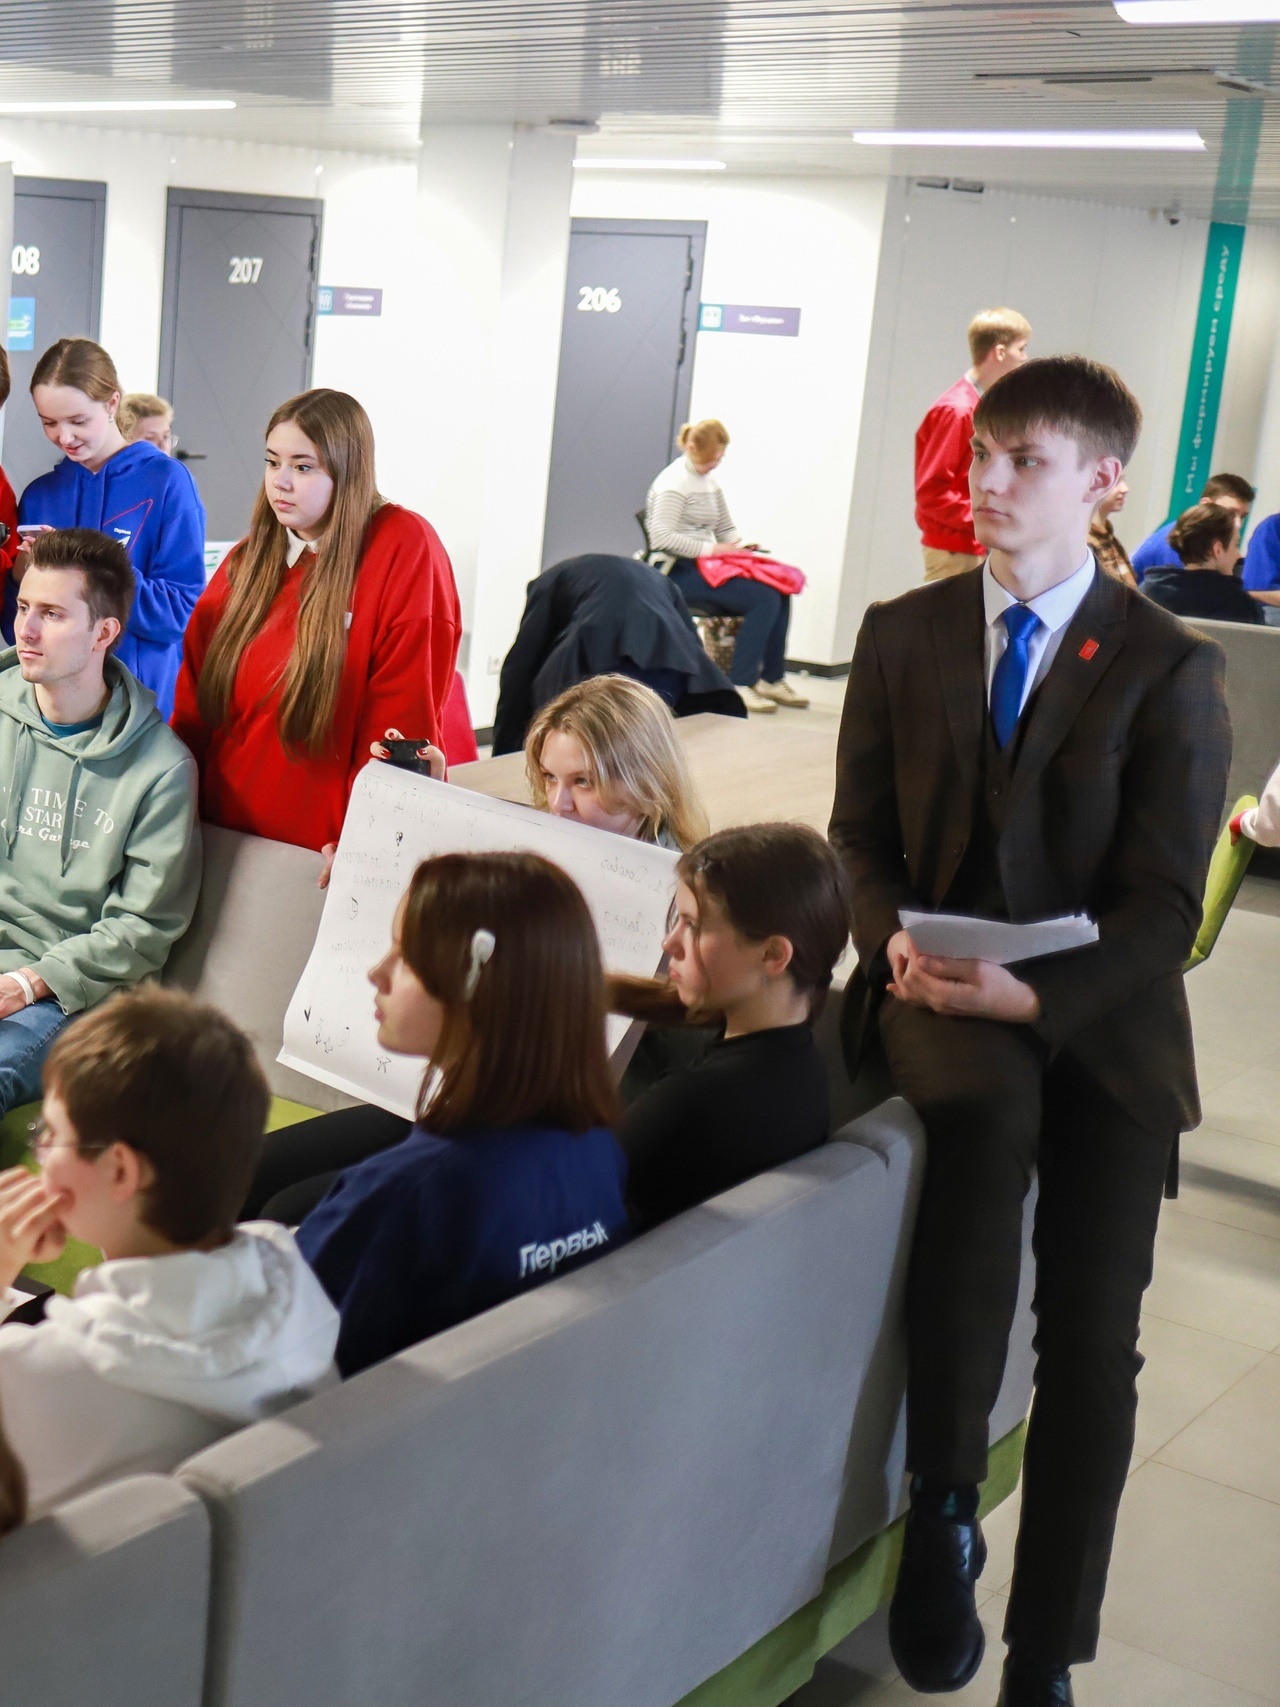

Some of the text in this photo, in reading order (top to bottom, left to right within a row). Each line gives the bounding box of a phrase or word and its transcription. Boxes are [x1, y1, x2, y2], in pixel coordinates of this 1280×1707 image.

[11, 245, 40, 275] 08
[228, 257, 263, 283] 207
[577, 286, 621, 313] 206
[1192, 318, 1218, 449] формируем
[1214, 244, 1229, 312] среду
[24, 807, 63, 828] STAR
[93, 808, 114, 834] TO
